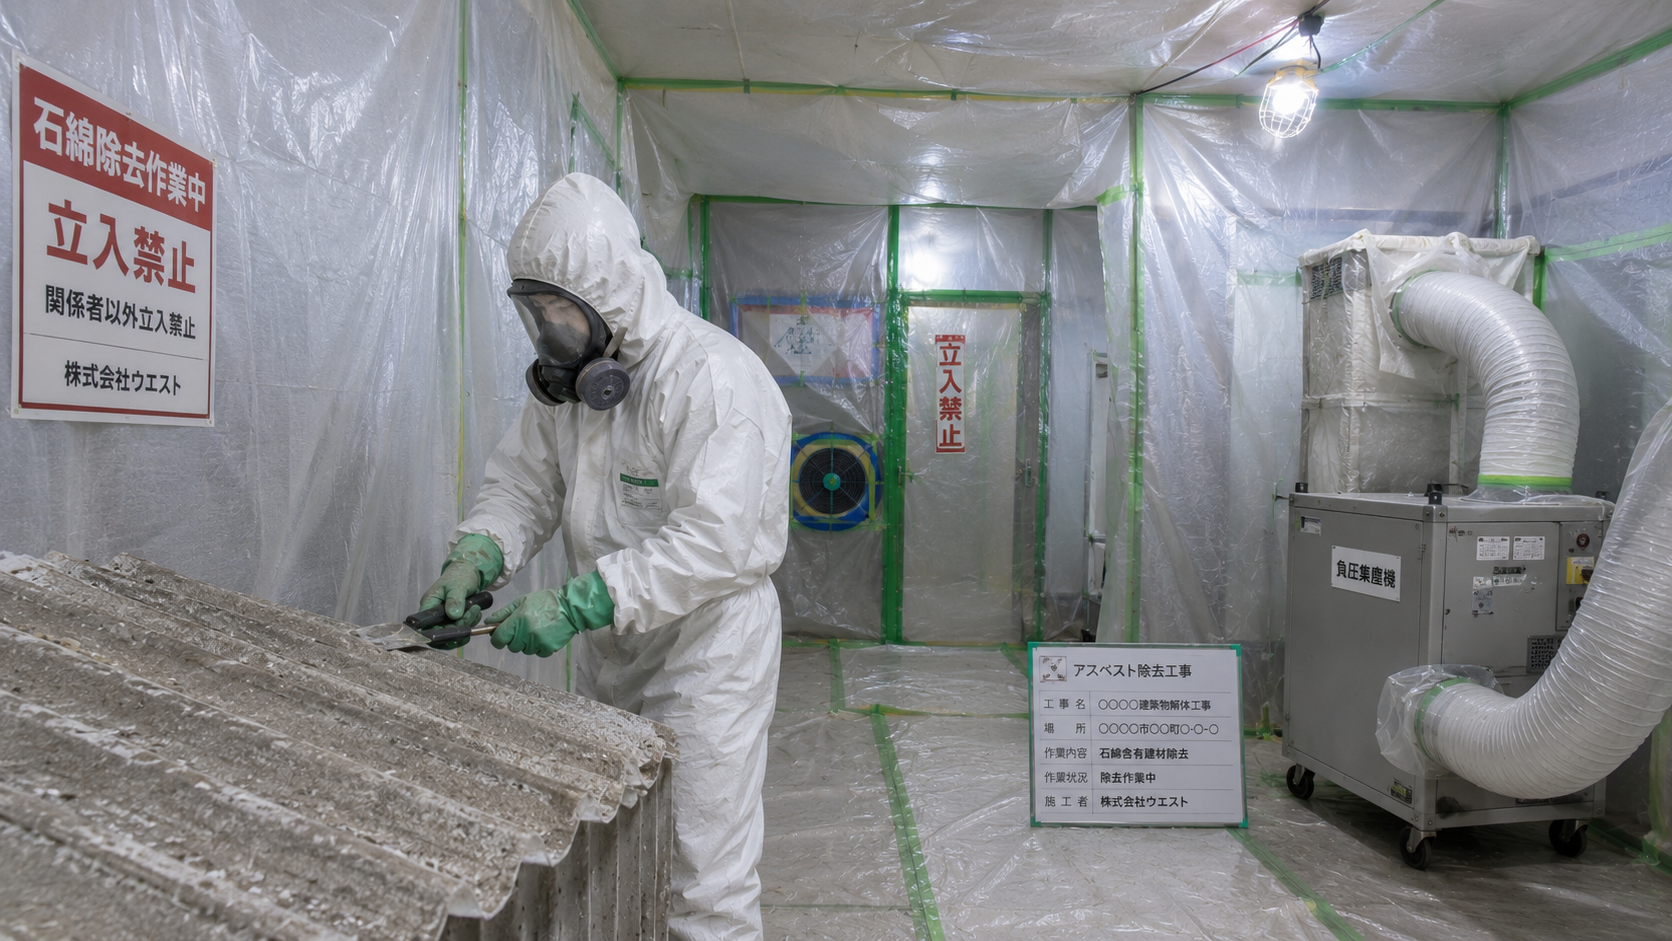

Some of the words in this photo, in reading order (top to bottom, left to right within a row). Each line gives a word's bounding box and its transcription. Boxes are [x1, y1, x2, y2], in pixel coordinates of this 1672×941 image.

[33, 97, 206, 212] 石綿除去作業中
[46, 199, 196, 294] 立入禁止
[45, 284, 196, 340] 関係者以外立入禁止
[64, 360, 182, 396] 株式会社ウエスト
[939, 342, 962, 447] 立入禁止
[1336, 559, 1396, 589] 負圧集塵機
[1073, 664, 1192, 678] アスベスト除去工事
[1100, 771, 1156, 784] 除去作業中
[1100, 796, 1189, 808] 株式会社ウエスト
